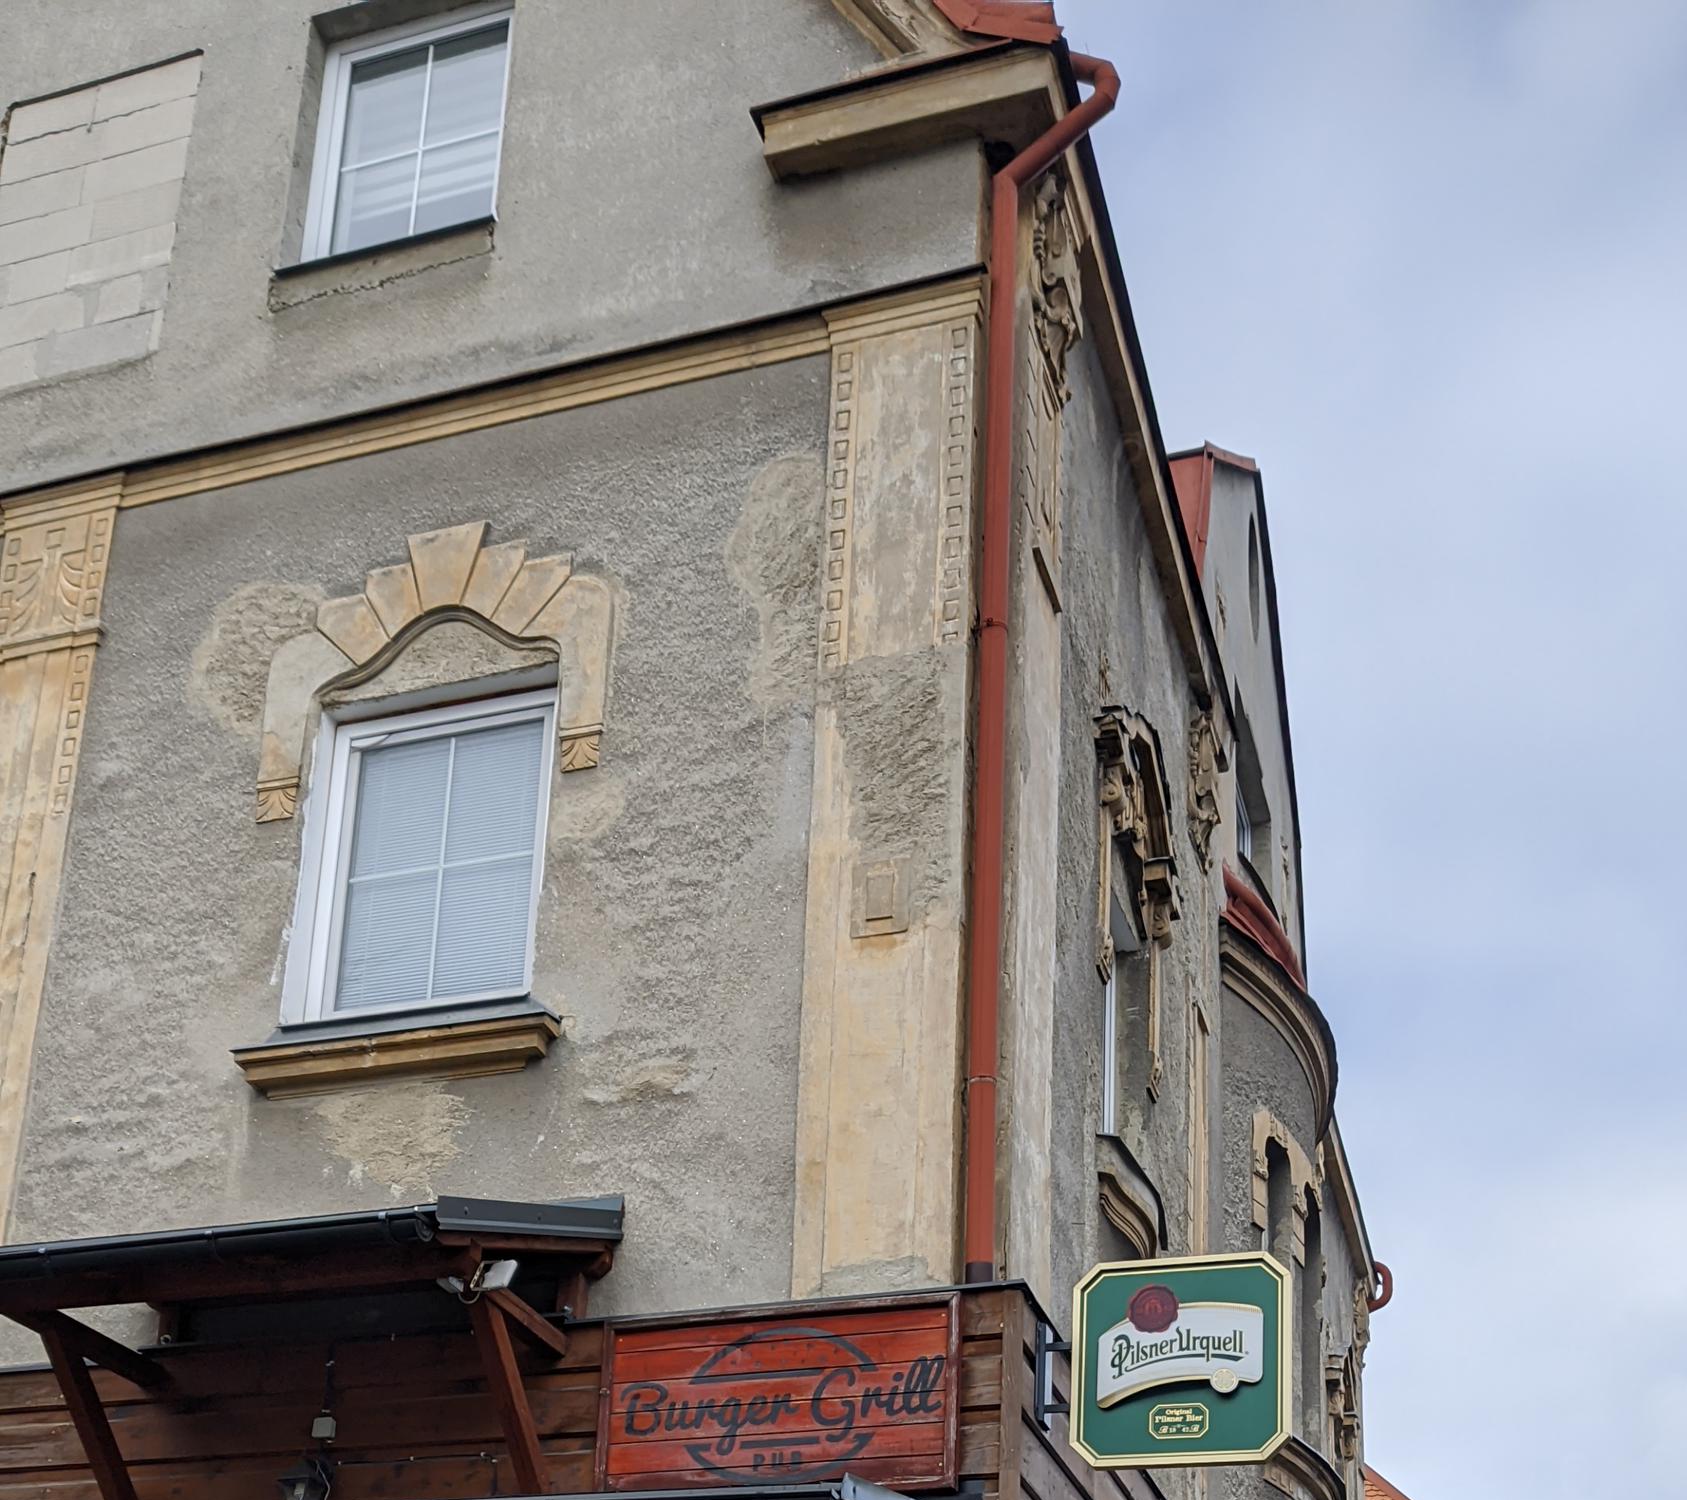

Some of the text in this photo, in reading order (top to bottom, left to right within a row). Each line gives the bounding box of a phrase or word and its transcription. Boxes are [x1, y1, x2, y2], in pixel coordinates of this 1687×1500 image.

[1110, 1327, 1244, 1380] Pilsner Urquell
[620, 1354, 945, 1456] Burger Grill
[752, 1450, 802, 1473] PUB
